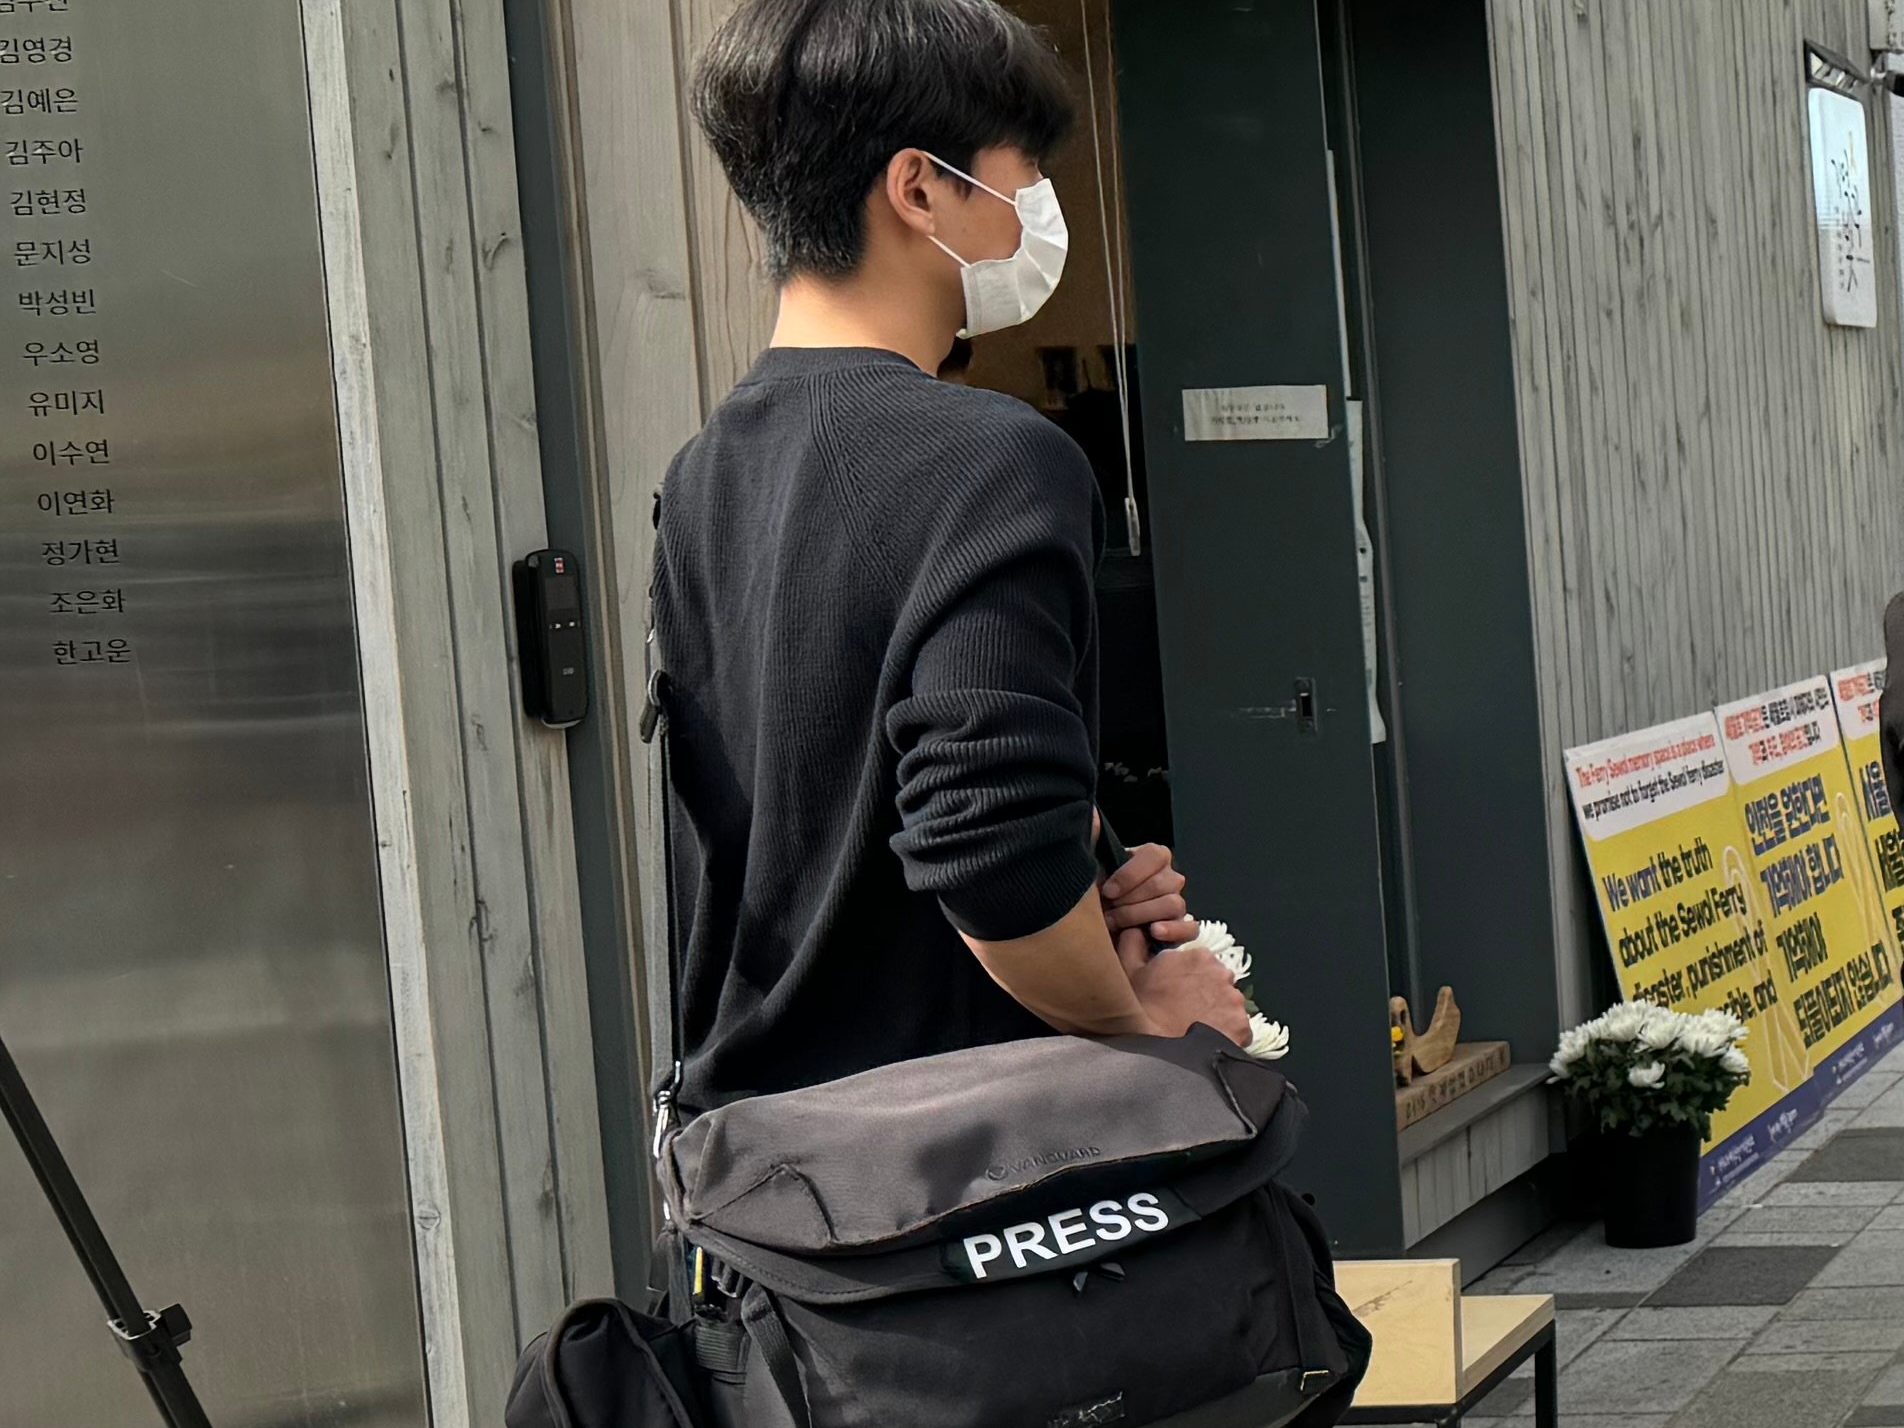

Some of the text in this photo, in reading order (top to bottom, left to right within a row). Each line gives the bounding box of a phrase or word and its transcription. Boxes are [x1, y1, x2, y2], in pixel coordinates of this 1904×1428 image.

[0, 36, 73, 64] 김영경
[1, 87, 78, 115] 김예은
[5, 138, 84, 166] 김주아
[9, 188, 87, 216] 김현정
[13, 238, 92, 267] 문지성
[18, 288, 97, 316] 박성빈
[23, 339, 100, 367] 우소영
[27, 389, 106, 417] 유미지
[32, 439, 111, 466] 이수연
[37, 489, 116, 517] 이연화
[41, 538, 121, 567] 정가현
[49, 588, 127, 616] 조은화
[53, 638, 132, 666] 한고운
[1745, 791, 1788, 857] 안전을
[1602, 836, 1714, 912] We want the truth
[1619, 883, 1747, 969] about the Sewol Ferry
[1686, 925, 1757, 1001] punishment
[1753, 919, 1769, 958] of
[1753, 968, 1778, 1013] and
[962, 1191, 1170, 1280] PRESS
